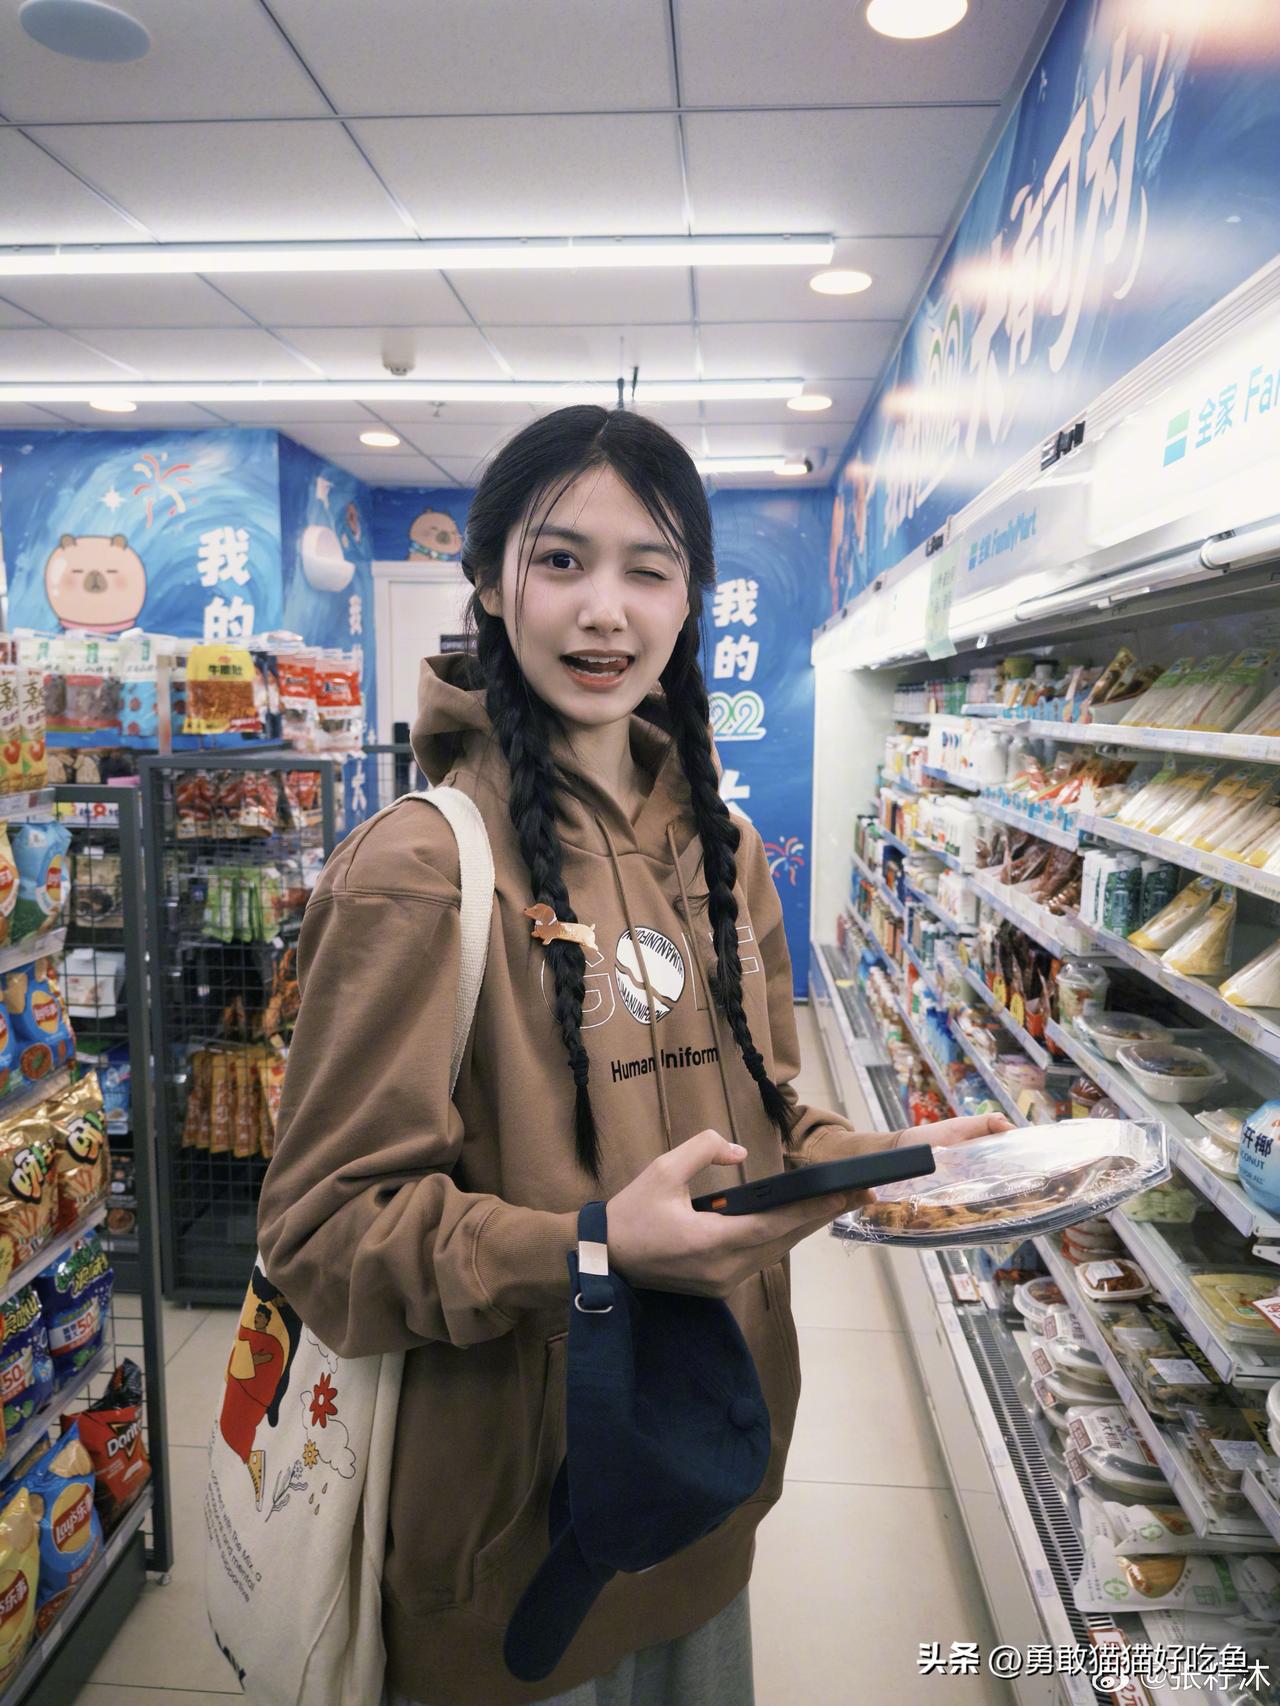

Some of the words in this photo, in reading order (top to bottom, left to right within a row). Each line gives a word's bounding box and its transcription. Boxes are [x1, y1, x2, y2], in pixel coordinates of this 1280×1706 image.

[1195, 383, 1238, 449] 全家
[1244, 365, 1280, 423] Fa
[611, 1056, 656, 1083] Human
